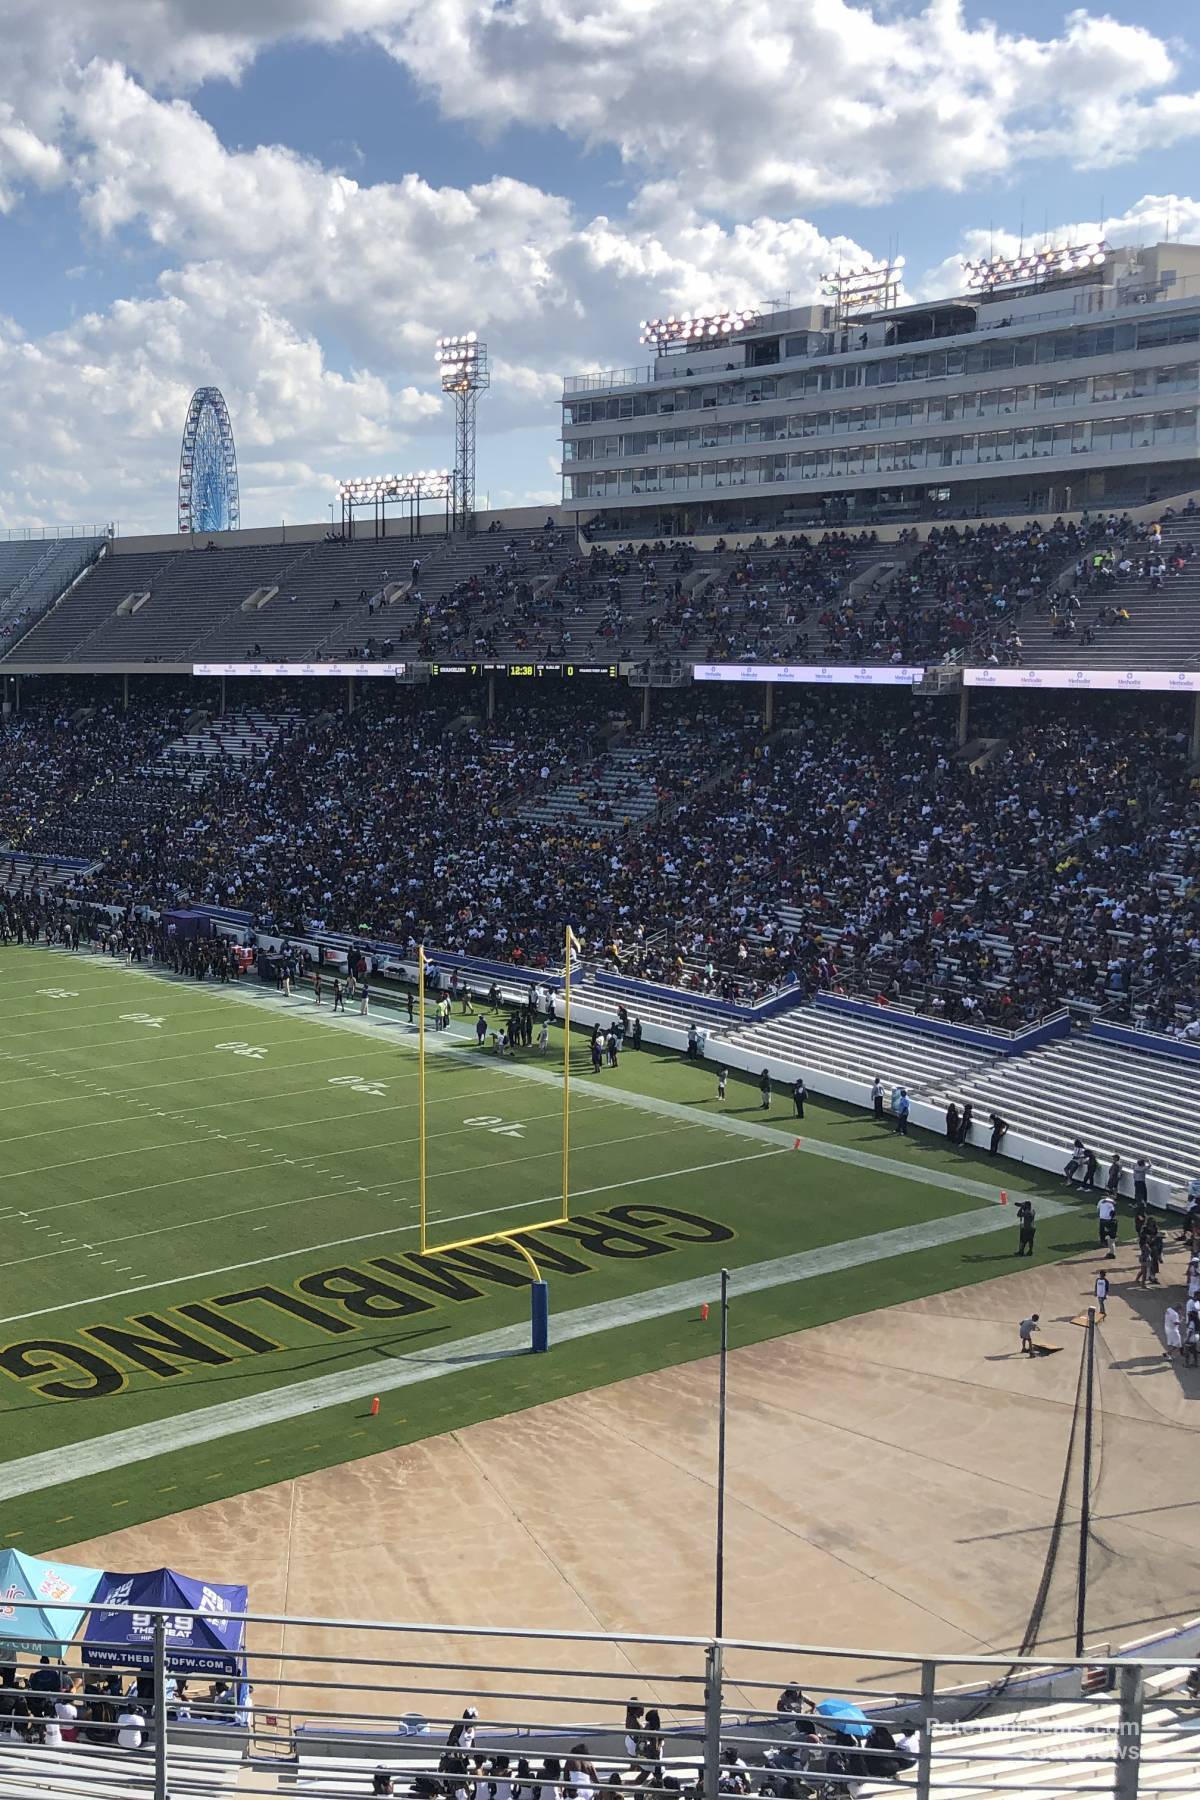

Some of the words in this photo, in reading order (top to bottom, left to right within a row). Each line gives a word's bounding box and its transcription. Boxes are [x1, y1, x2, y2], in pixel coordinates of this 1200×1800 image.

[471, 666, 477, 675] 7
[510, 666, 533, 676] 12:38
[567, 666, 574, 676] 0
[118, 1013, 166, 1023] 40
[214, 1041, 268, 1055] 30
[327, 1075, 391, 1094] 20
[462, 1116, 528, 1134] 10
[132, 1626, 156, 1634] THE
[88, 1650, 224, 1669] WWW.THEBTDFW.COM
